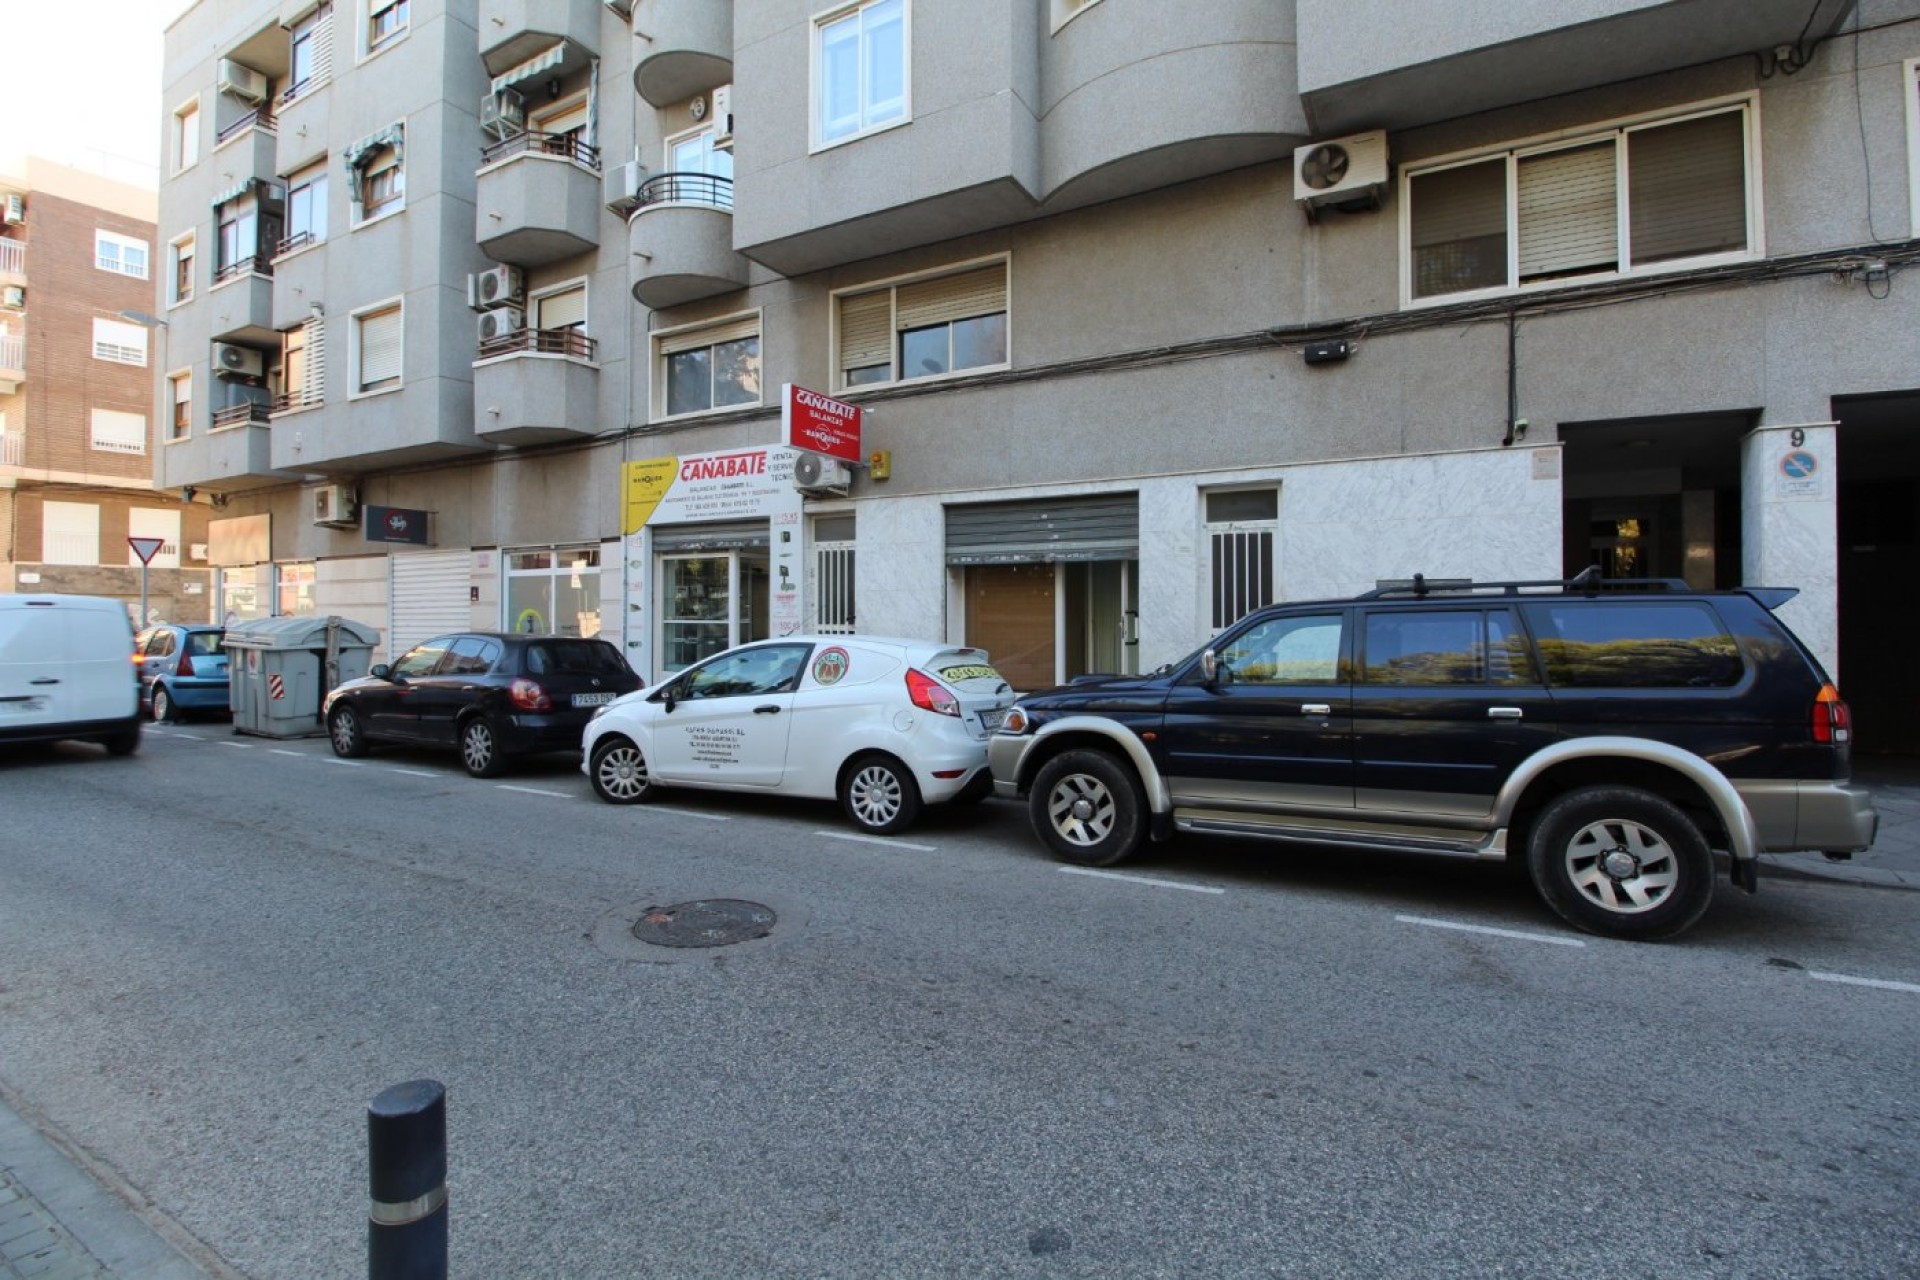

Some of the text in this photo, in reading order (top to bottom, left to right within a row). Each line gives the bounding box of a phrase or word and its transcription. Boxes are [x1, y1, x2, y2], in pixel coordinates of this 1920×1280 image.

[1791, 428, 1805, 448] 9
[680, 450, 768, 482] CAÑABATE
[772, 452, 793, 461] VENTA
